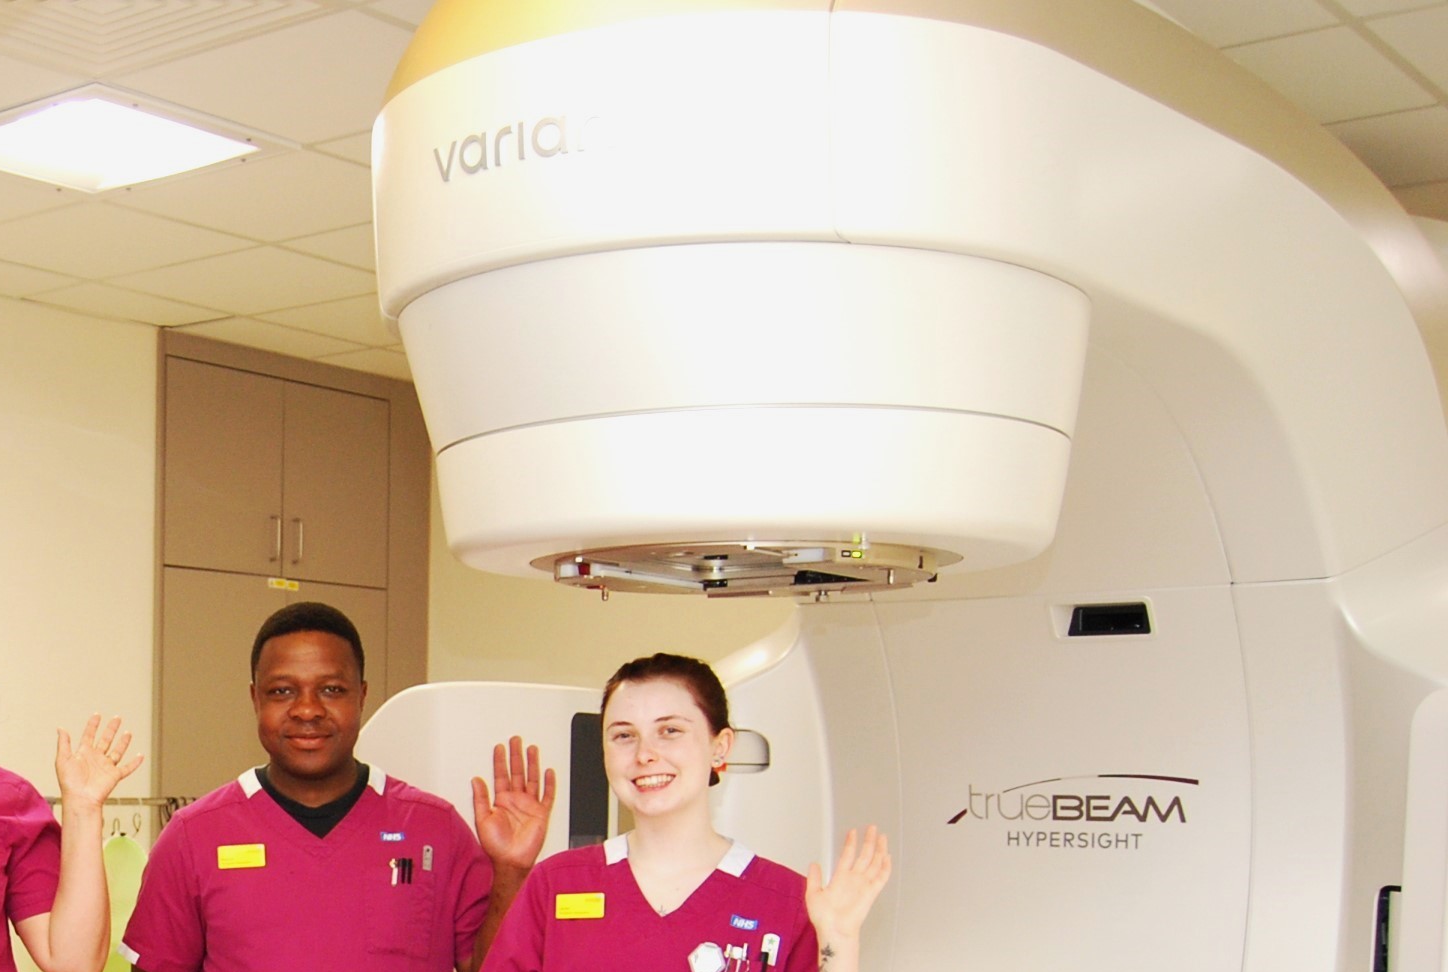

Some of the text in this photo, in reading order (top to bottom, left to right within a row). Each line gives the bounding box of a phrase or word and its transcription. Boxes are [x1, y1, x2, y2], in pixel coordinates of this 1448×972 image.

[433, 115, 600, 183] varia
[968, 784, 1186, 823] trueBEAM
[1007, 831, 1143, 850] HYPERSIGHT
[732, 917, 755, 930] NHS
